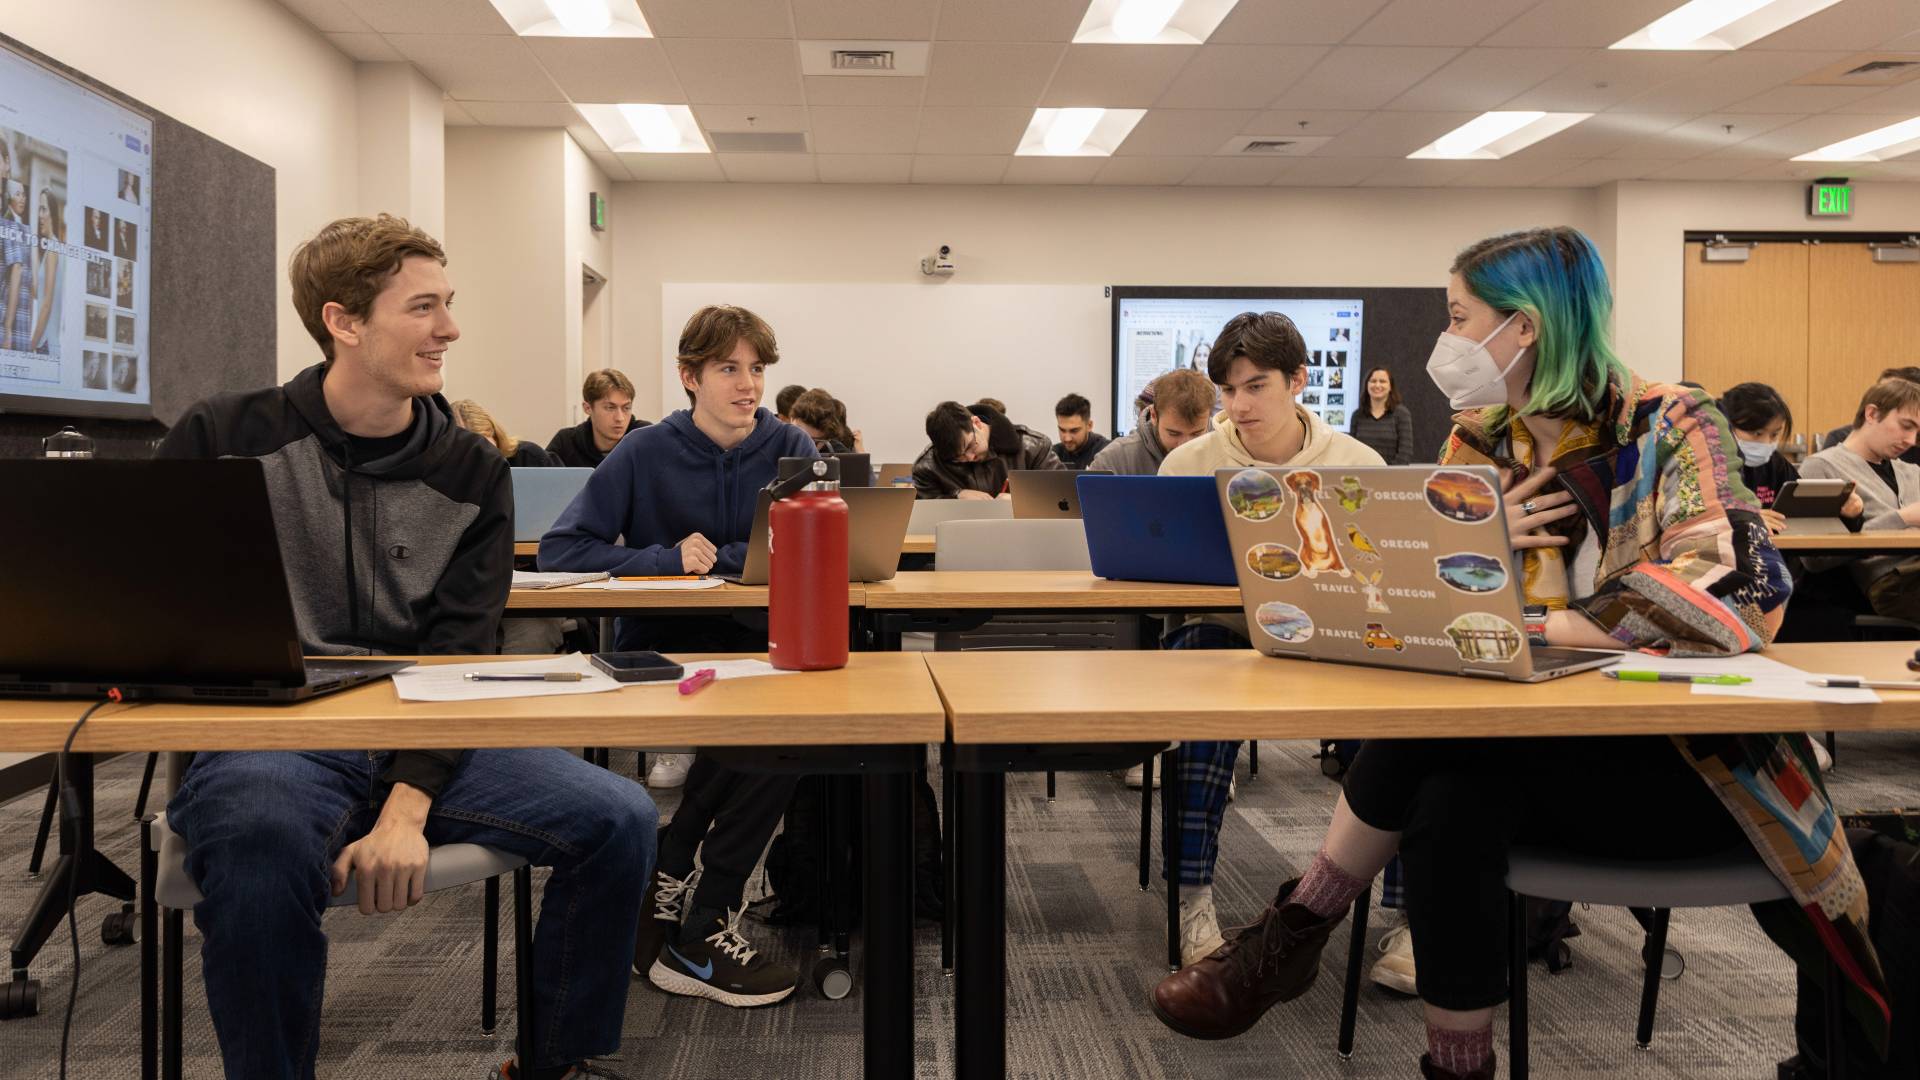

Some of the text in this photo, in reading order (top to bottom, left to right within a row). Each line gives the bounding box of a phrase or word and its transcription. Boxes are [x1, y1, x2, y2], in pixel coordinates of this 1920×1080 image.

[1819, 187, 1851, 213] EXIT
[25, 233, 38, 246] TO
[1104, 285, 1111, 298] B
[1374, 491, 1424, 501] OREGON
[1380, 539, 1430, 550] OREGON
[1313, 583, 1437, 599] TRAVEL OREGON
[1318, 628, 1454, 648] TRAVEL OREGON
